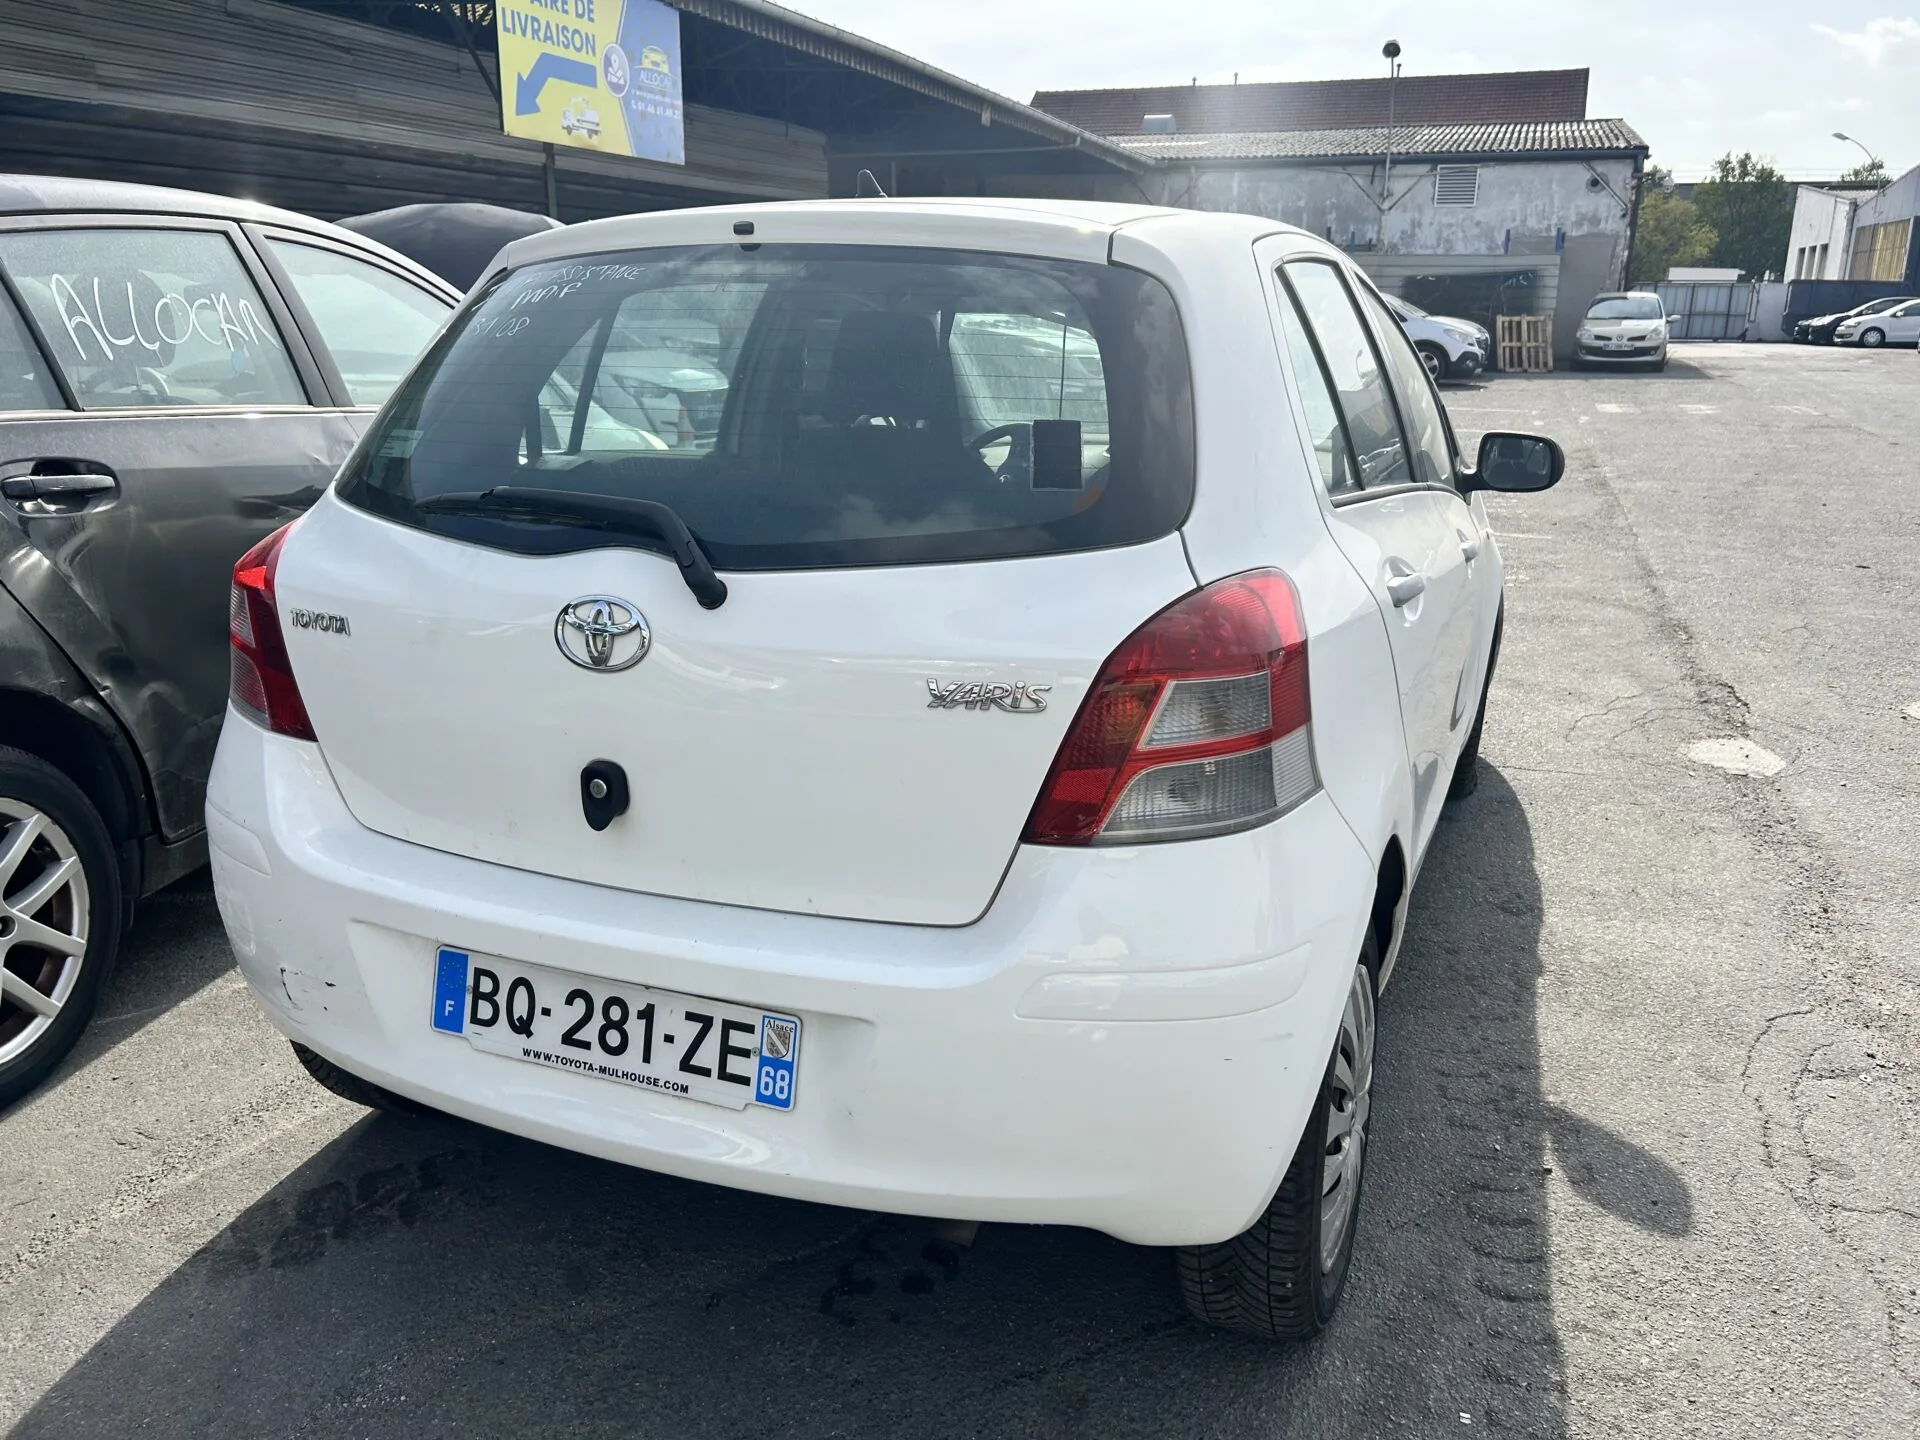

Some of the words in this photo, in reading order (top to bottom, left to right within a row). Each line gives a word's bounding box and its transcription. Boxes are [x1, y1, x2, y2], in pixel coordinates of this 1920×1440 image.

[575, 0, 595, 23] DE
[501, 6, 597, 57] LIVRAISON
[50, 273, 282, 361] ALLOCAR
[290, 608, 351, 636] TOYOTA
[445, 1000, 454, 1018] F
[765, 1019, 794, 1033] Alsace
[522, 1047, 689, 1094] WWW.TOYOTA-MULHOUSE.COM
[760, 1065, 790, 1100] 68
